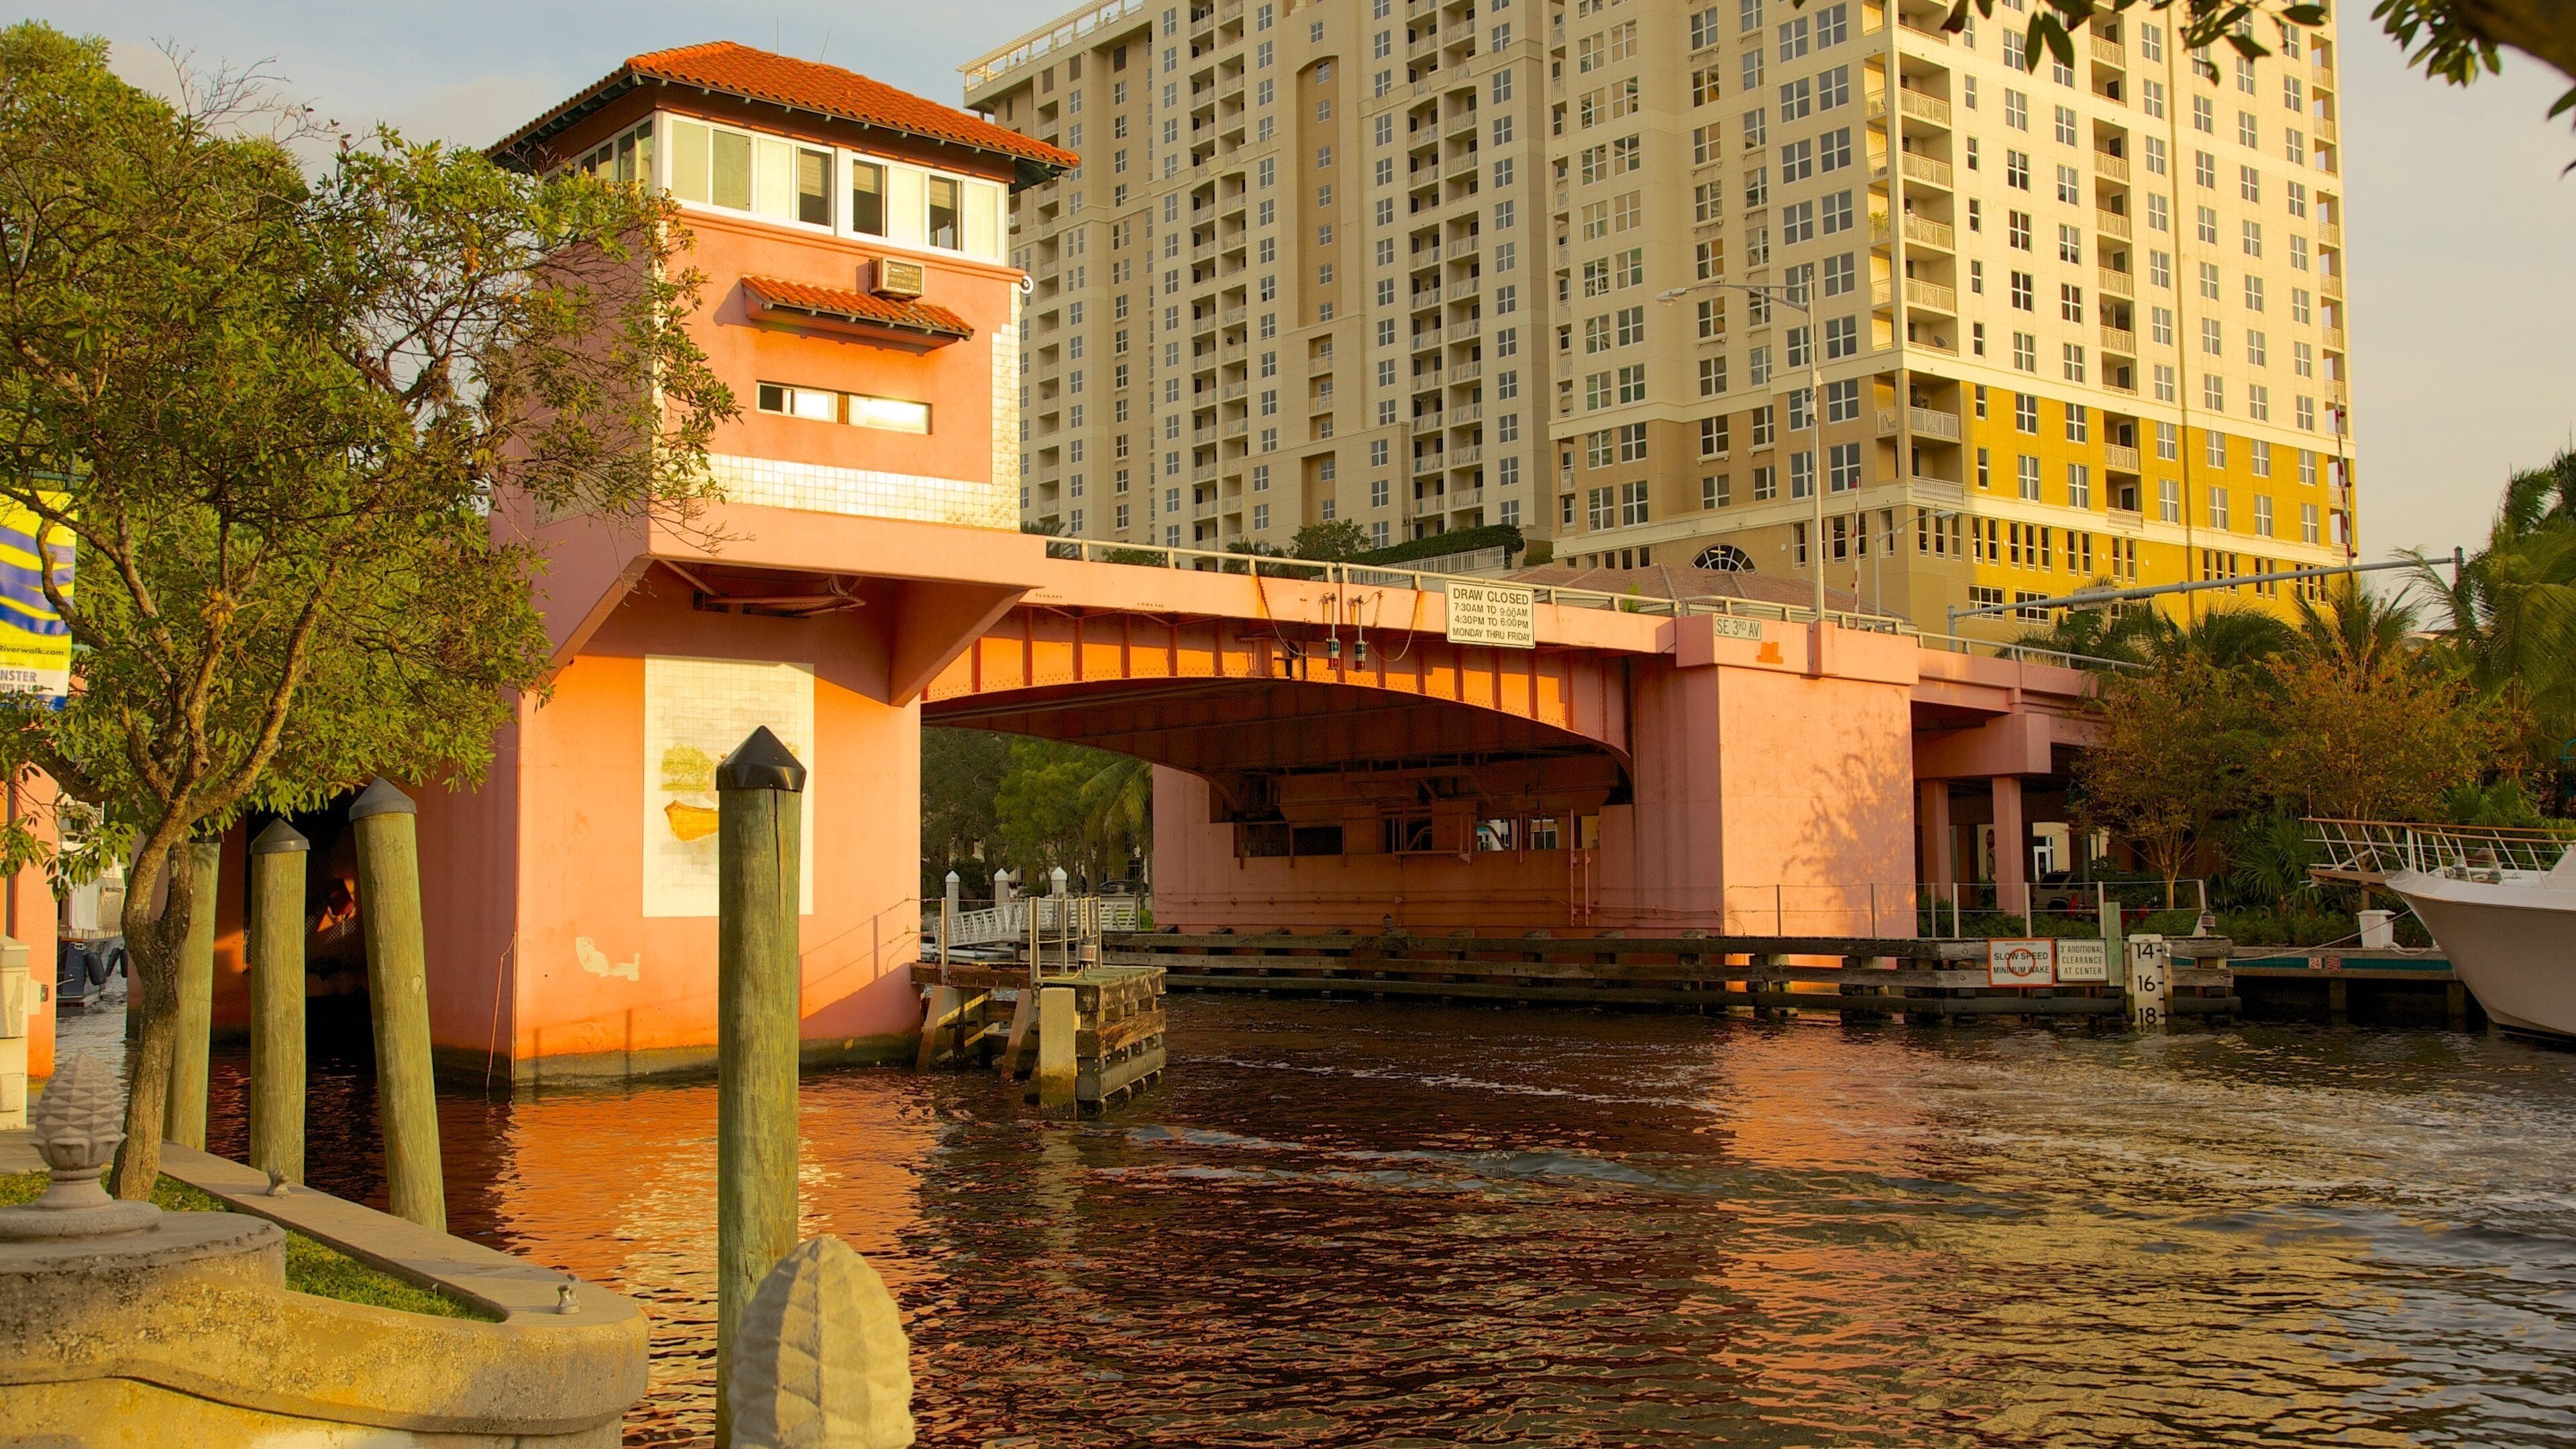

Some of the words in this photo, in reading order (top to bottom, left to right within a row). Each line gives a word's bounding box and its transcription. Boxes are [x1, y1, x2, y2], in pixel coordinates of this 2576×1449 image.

[1453, 588, 1483, 601] DRAW
[1487, 591, 1528, 604] CLOSED
[1454, 602, 1483, 613] 7:30AM
[1486, 605, 1497, 614] TO
[1499, 607, 1527, 617] 9:00AM
[1454, 615, 1485, 625] 4:30PM
[1487, 617, 1497, 627] TO
[1500, 618, 1528, 629] 6:00PM
[1717, 619, 1729, 634] SE
[1733, 621, 1746, 635] 3RD
[1748, 623, 1760, 637] AV
[1452, 627, 1483, 637] MONDAY
[1486, 630, 1505, 639] THRU
[1507, 631, 1530, 641] FRIDAY
[1994, 952, 2019, 961] SLOW
[2021, 952, 2048, 960] SPEED
[2068, 945, 2104, 953] ADDITIONAL
[2136, 943, 2155, 959] 14
[1993, 966, 2026, 974] MINIMUM
[2137, 975, 2155, 991] 16
[2138, 1007, 2157, 1024] 18
